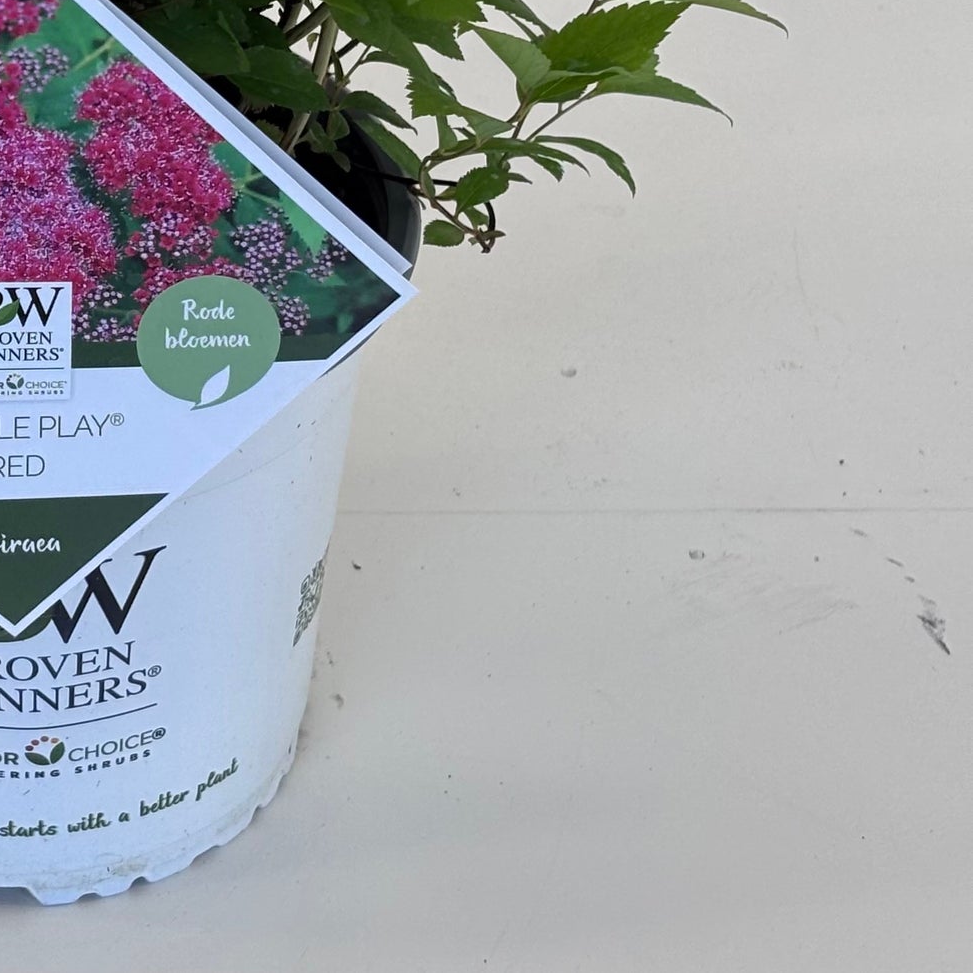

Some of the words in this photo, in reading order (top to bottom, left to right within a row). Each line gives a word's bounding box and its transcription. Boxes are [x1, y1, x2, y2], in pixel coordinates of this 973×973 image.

[181, 298, 236, 321] Rode
[164, 327, 251, 349] bloemen
[25, 380, 67, 389] CHOICE
[74, 748, 151, 774] SHRUBS
[67, 812, 111, 833] with
[118, 811, 130, 823] a
[139, 789, 190, 817] better
[195, 757, 239, 802] plant
